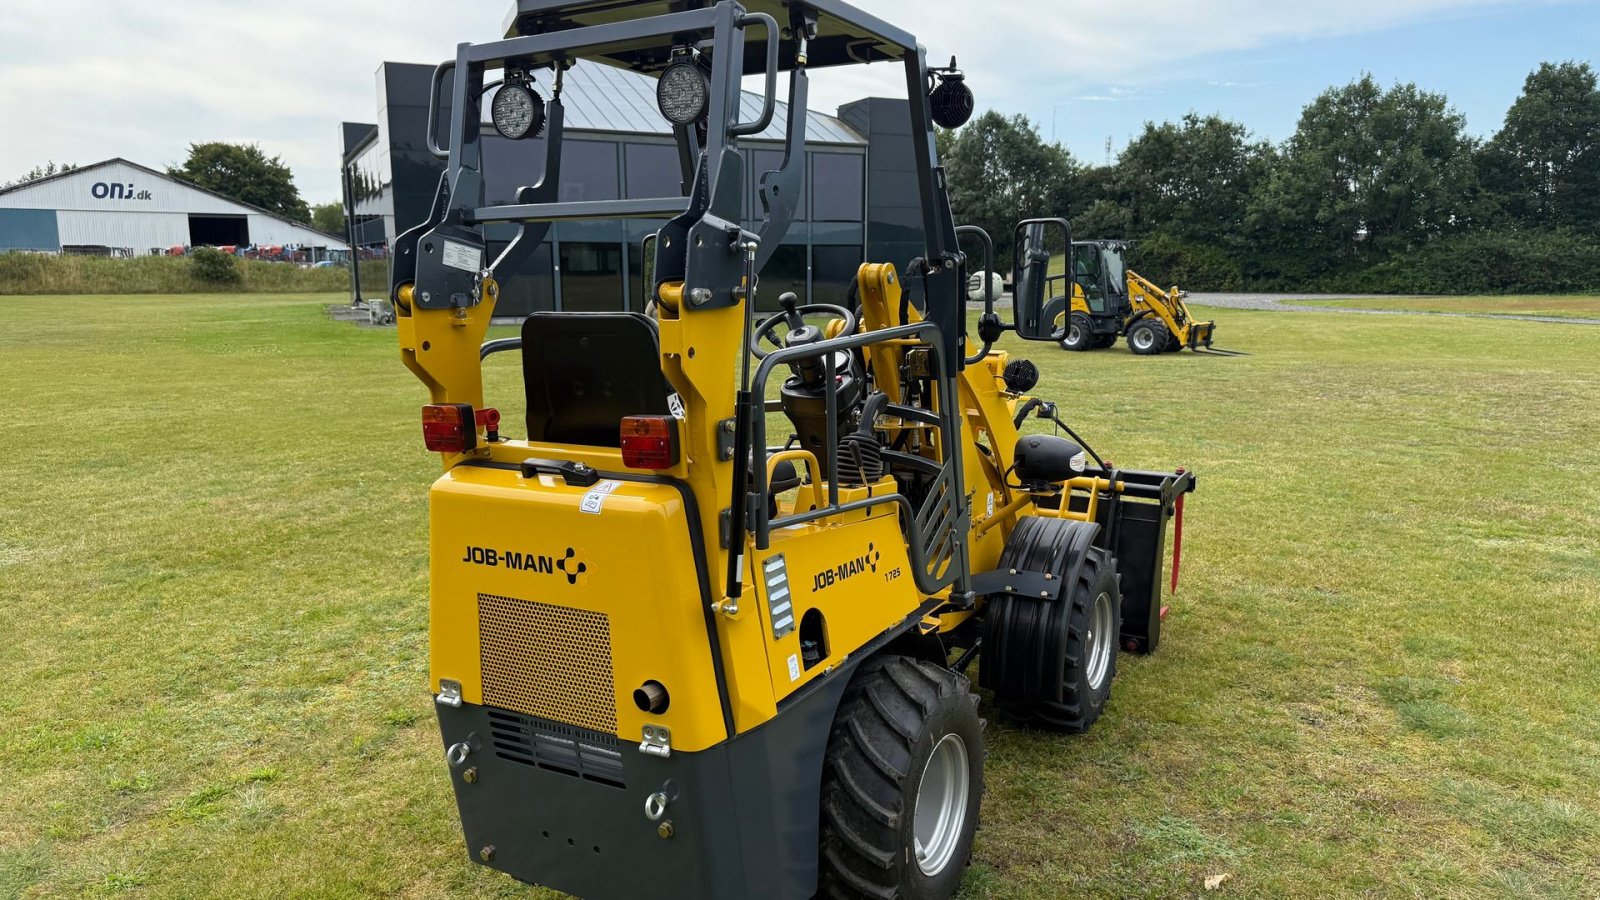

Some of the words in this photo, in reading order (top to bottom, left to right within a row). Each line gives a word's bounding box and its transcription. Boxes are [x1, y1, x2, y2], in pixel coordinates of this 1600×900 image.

[91, 182, 152, 200] onj.dk
[462, 546, 553, 574] JOB-MAN
[812, 557, 865, 592] JOB-MAN
[884, 567, 901, 582] 1725
